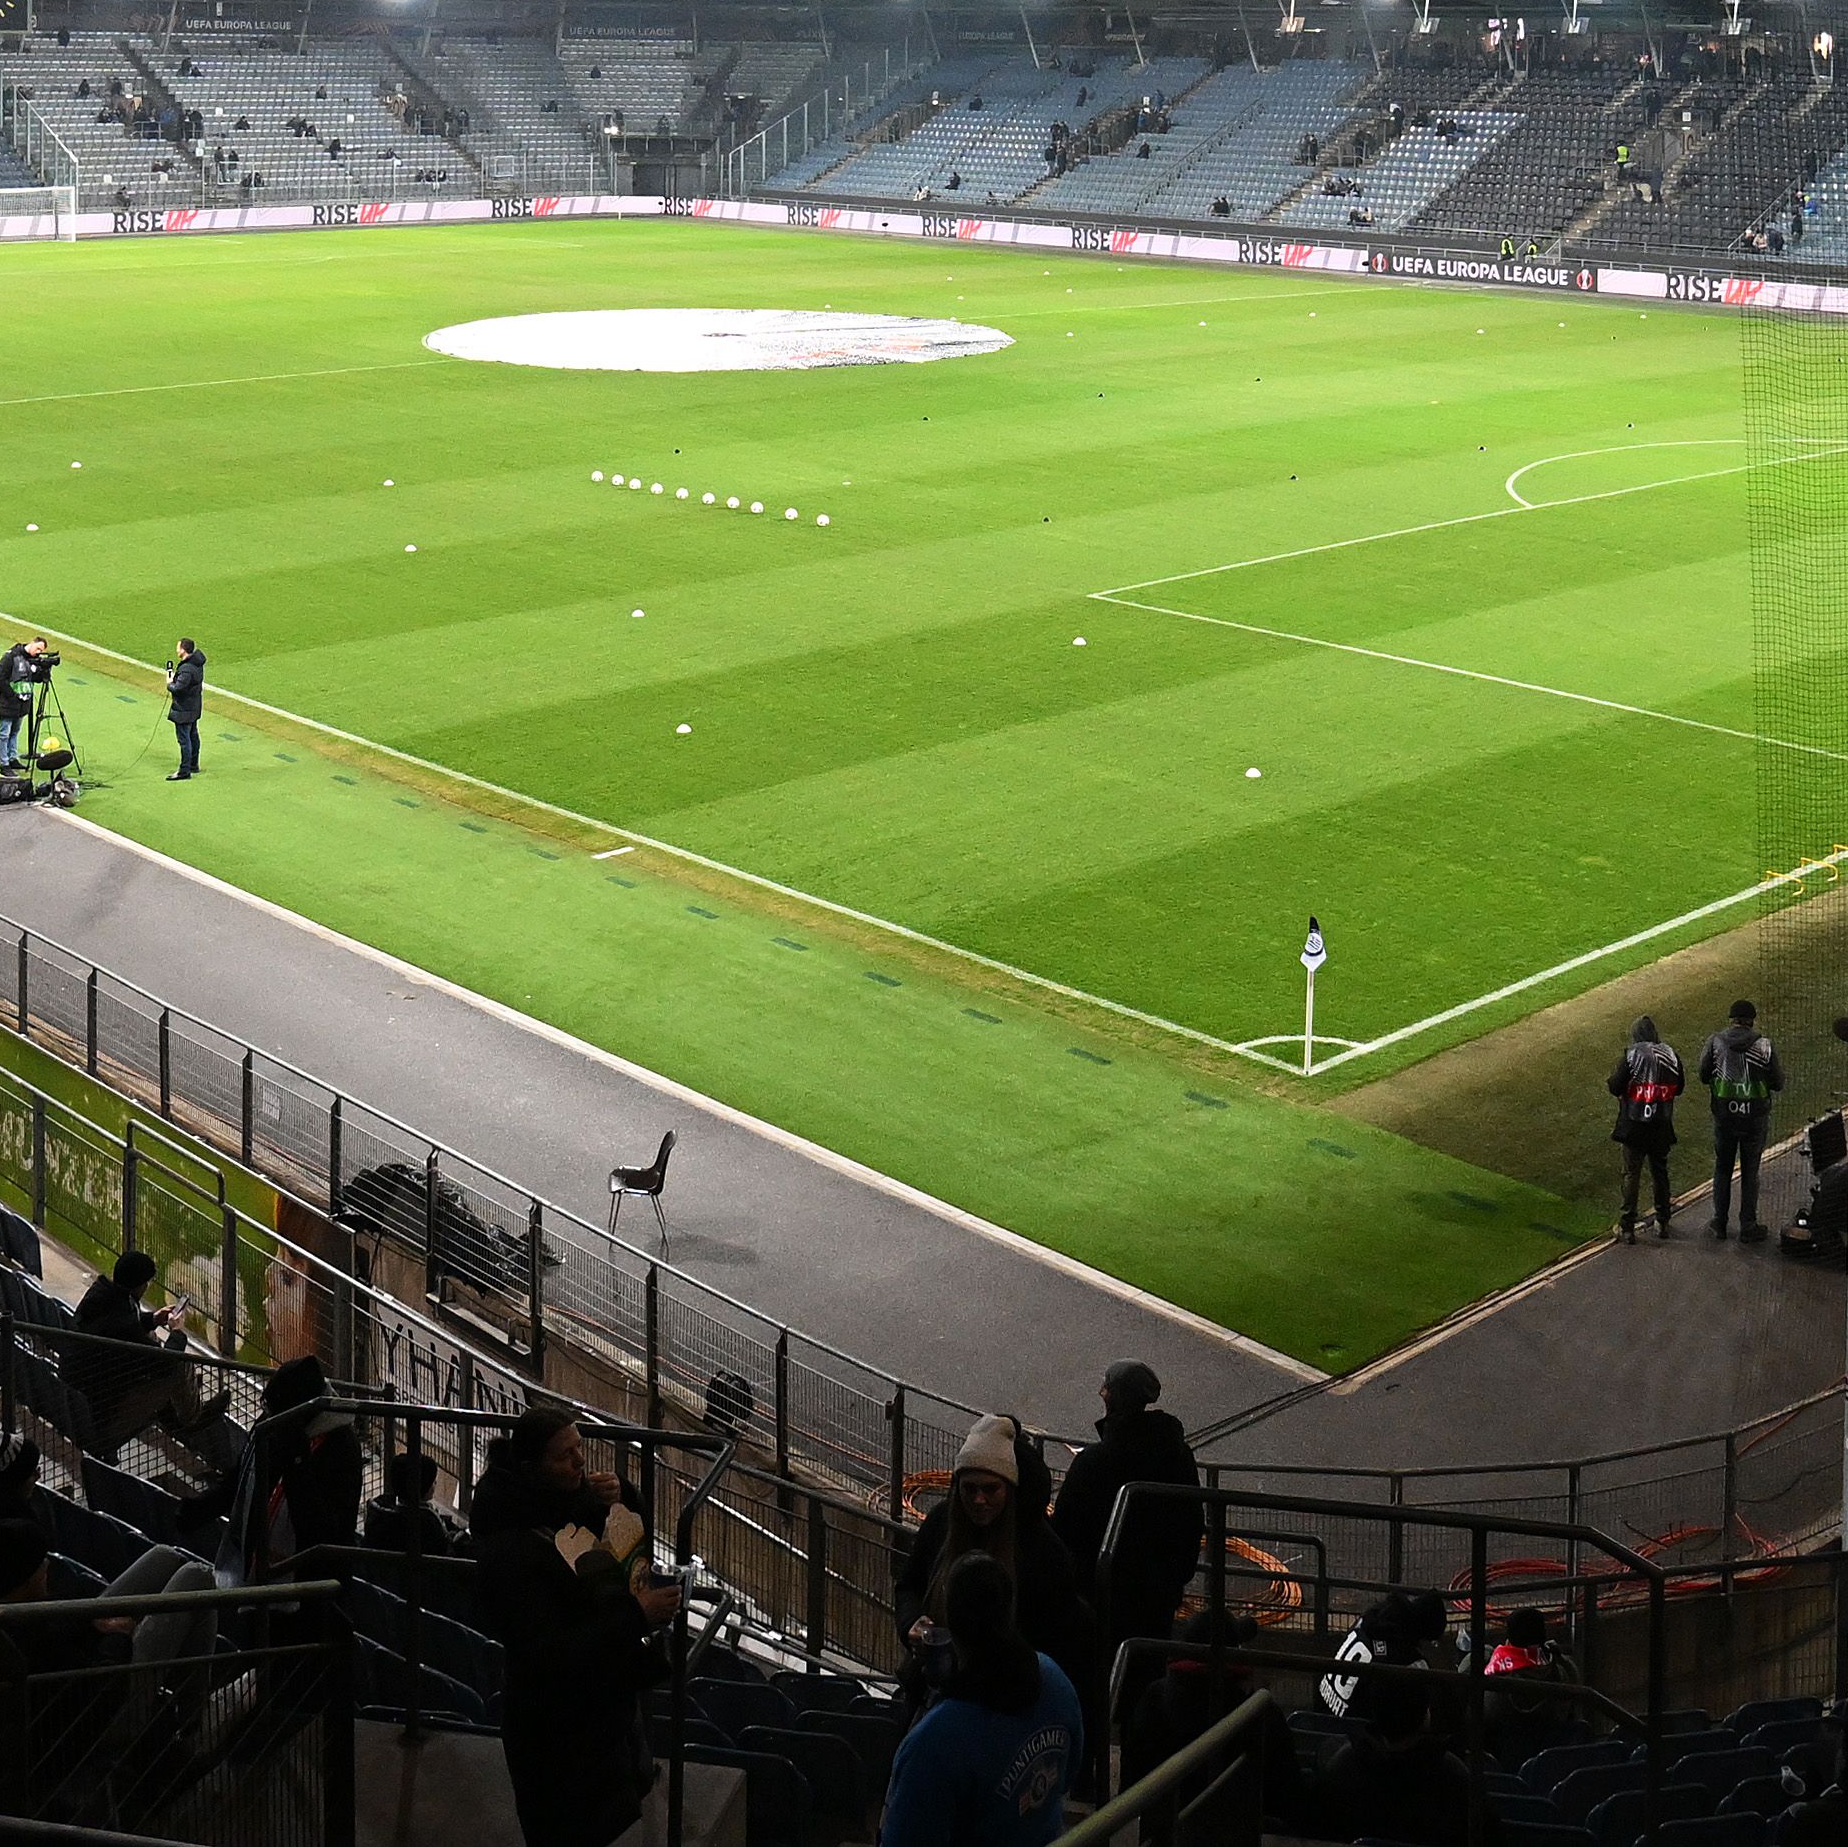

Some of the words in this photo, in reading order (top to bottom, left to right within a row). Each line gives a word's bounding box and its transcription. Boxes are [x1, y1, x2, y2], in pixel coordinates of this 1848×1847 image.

[186, 20, 212, 29] UEFA
[215, 21, 252, 30] EUROPA
[255, 22, 292, 31] LEAGUE
[313, 204, 357, 225] RISE
[360, 203, 389, 224] UP
[492, 198, 532, 218] RISE
[534, 197, 560, 216] UP
[664, 196, 693, 216] RISE
[694, 198, 714, 217] UP
[788, 205, 818, 227] RISE
[820, 208, 841, 228] UP
[113, 211, 163, 234] RISE
[166, 209, 198, 232] UP
[922, 215, 957, 238] RISE
[958, 219, 982, 239] UP
[1071, 226, 1110, 251] RISE
[1112, 230, 1138, 252] UP
[1238, 240, 1281, 265] RISE
[1284, 244, 1313, 268] UP
[1393, 256, 1434, 274] UEFA
[1437, 259, 1500, 281] EUROPA
[1504, 265, 1569, 286] LEAGUE
[1665, 272, 1721, 303] RISE
[1723, 279, 1763, 305] UP
[1733, 1082, 1752, 1097] TV
